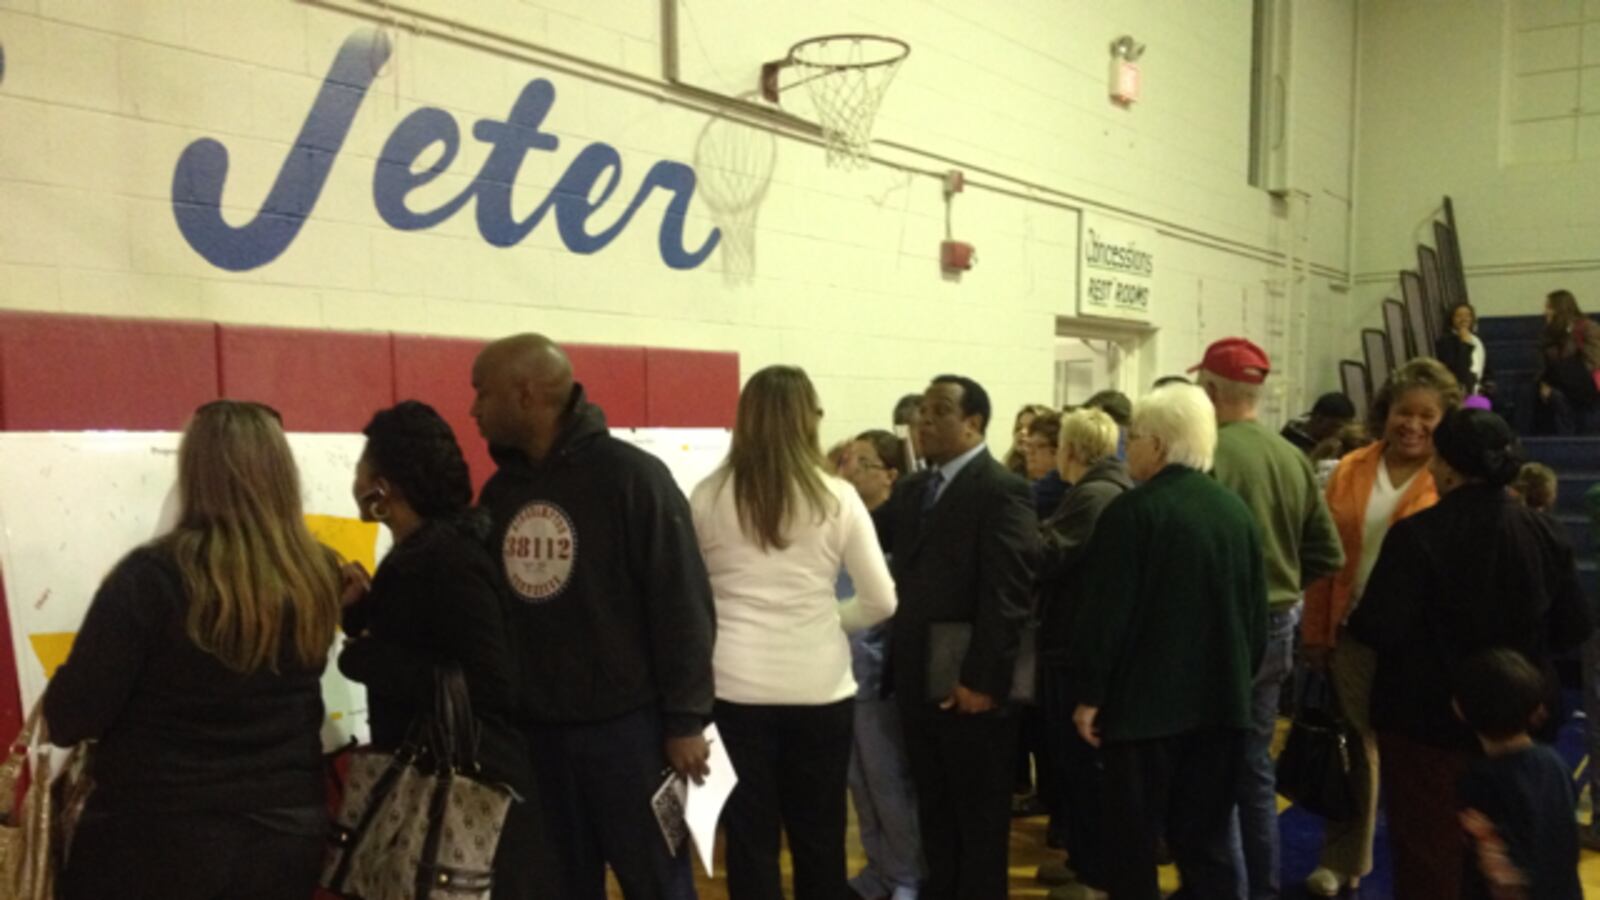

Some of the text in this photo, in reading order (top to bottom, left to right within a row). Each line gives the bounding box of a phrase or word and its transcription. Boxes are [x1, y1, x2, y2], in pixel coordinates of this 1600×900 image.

[171, 27, 722, 272] Jeter
[1085, 227, 1153, 274] Concessions
[1088, 278, 1149, 308] REST ROOMS
[506, 535, 571, 560] 38112
